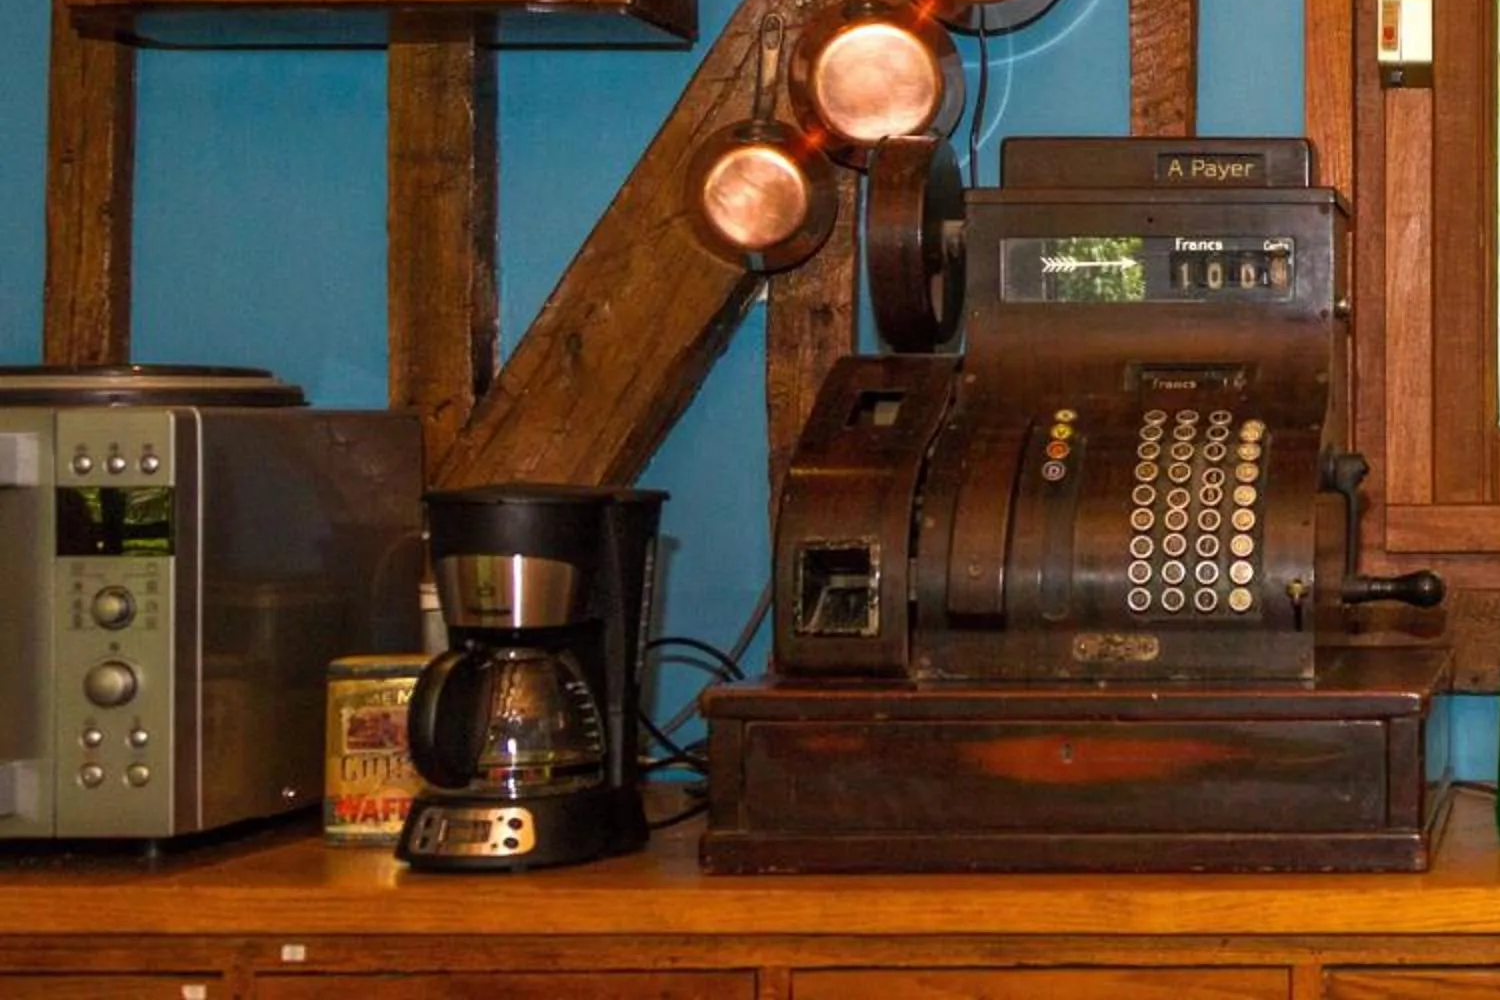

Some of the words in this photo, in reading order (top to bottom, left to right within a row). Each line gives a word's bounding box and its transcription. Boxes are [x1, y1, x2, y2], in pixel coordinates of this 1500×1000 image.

[1167, 159, 1184, 177] A
[1191, 159, 1255, 181] Payer
[1175, 237, 1223, 251] Francs
